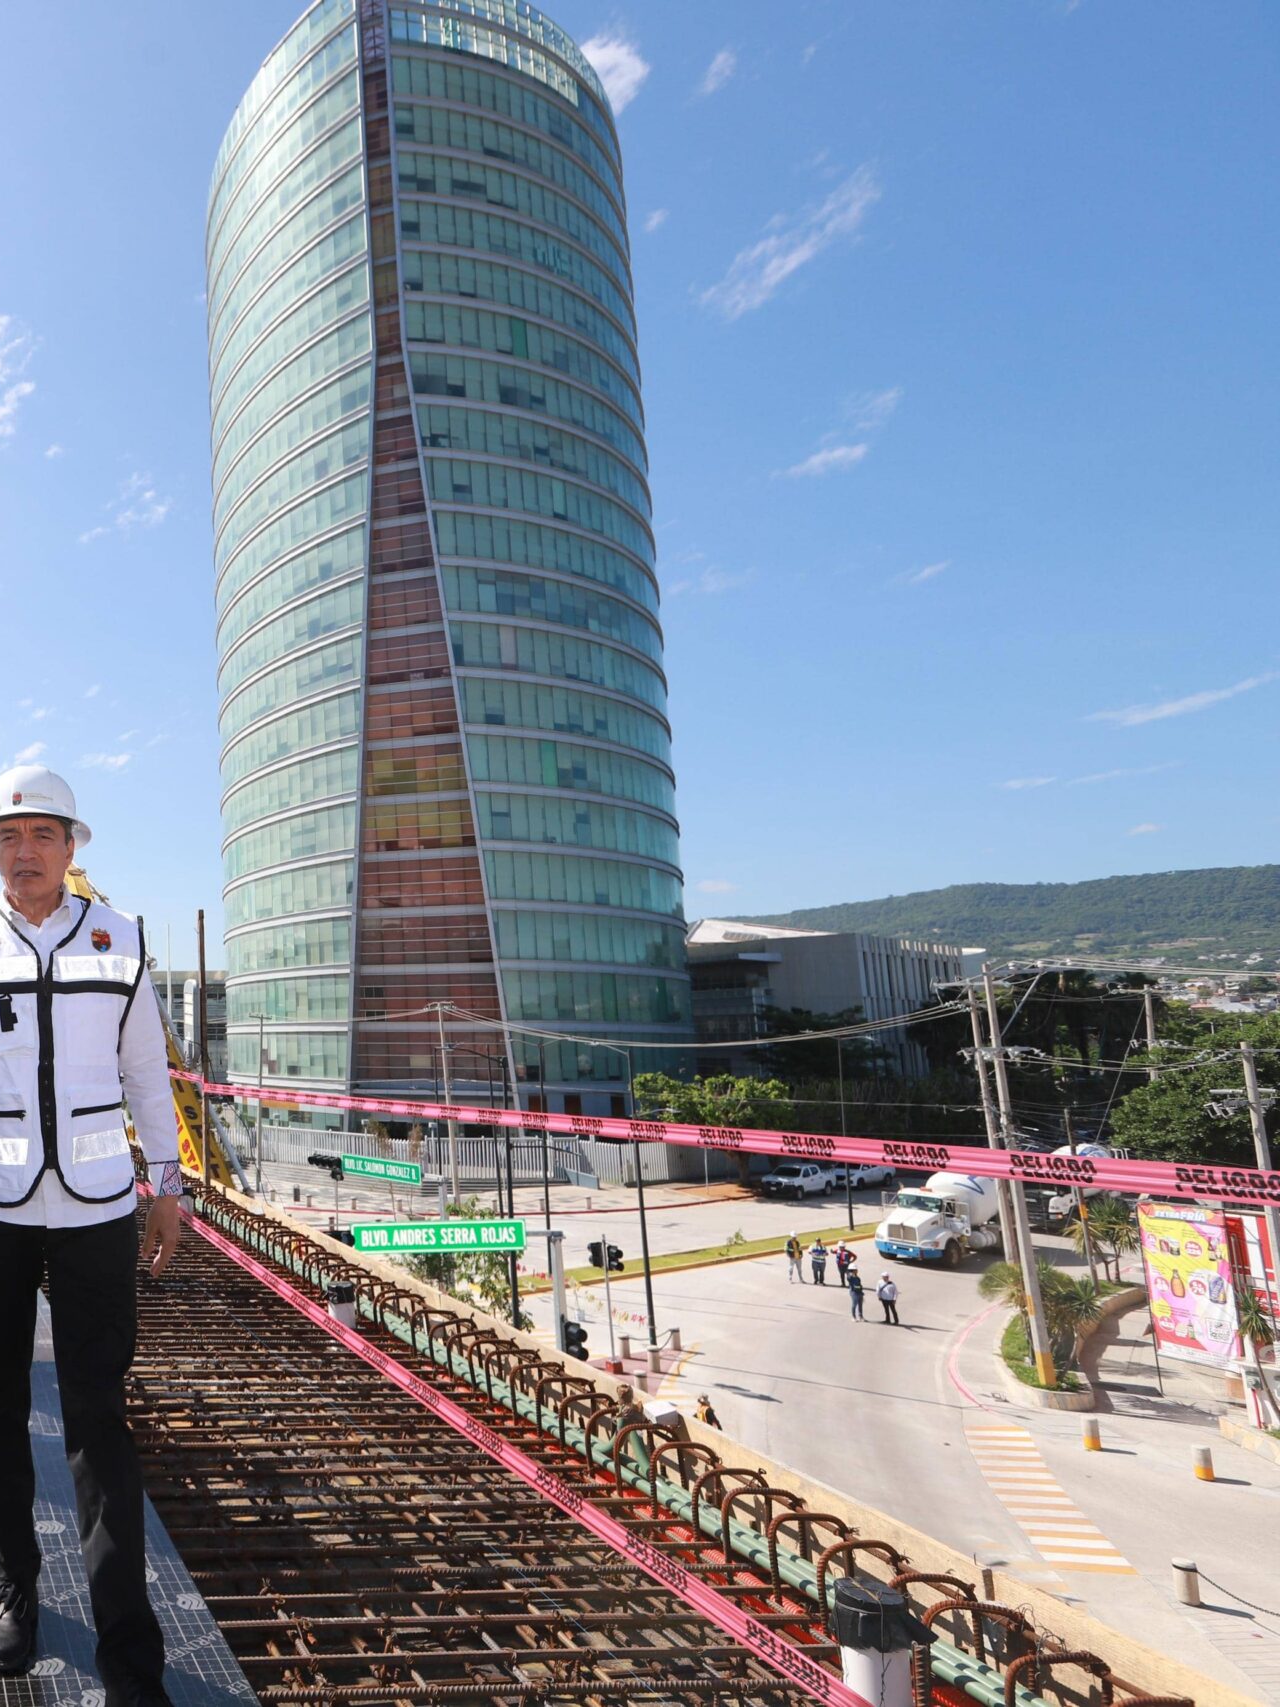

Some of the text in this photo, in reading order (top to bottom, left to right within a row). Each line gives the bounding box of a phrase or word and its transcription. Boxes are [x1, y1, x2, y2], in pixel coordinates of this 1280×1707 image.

[697, 1127, 744, 1149] PELIGRO
[780, 1134, 837, 1158] PELIGRO
[882, 1142, 951, 1169] PELIGRO
[1009, 1153, 1098, 1184] PELIGRO
[1174, 1166, 1280, 1200] PELIGRO
[361, 1226, 517, 1247] BLVD. ANDRES SERRA ROJAS
